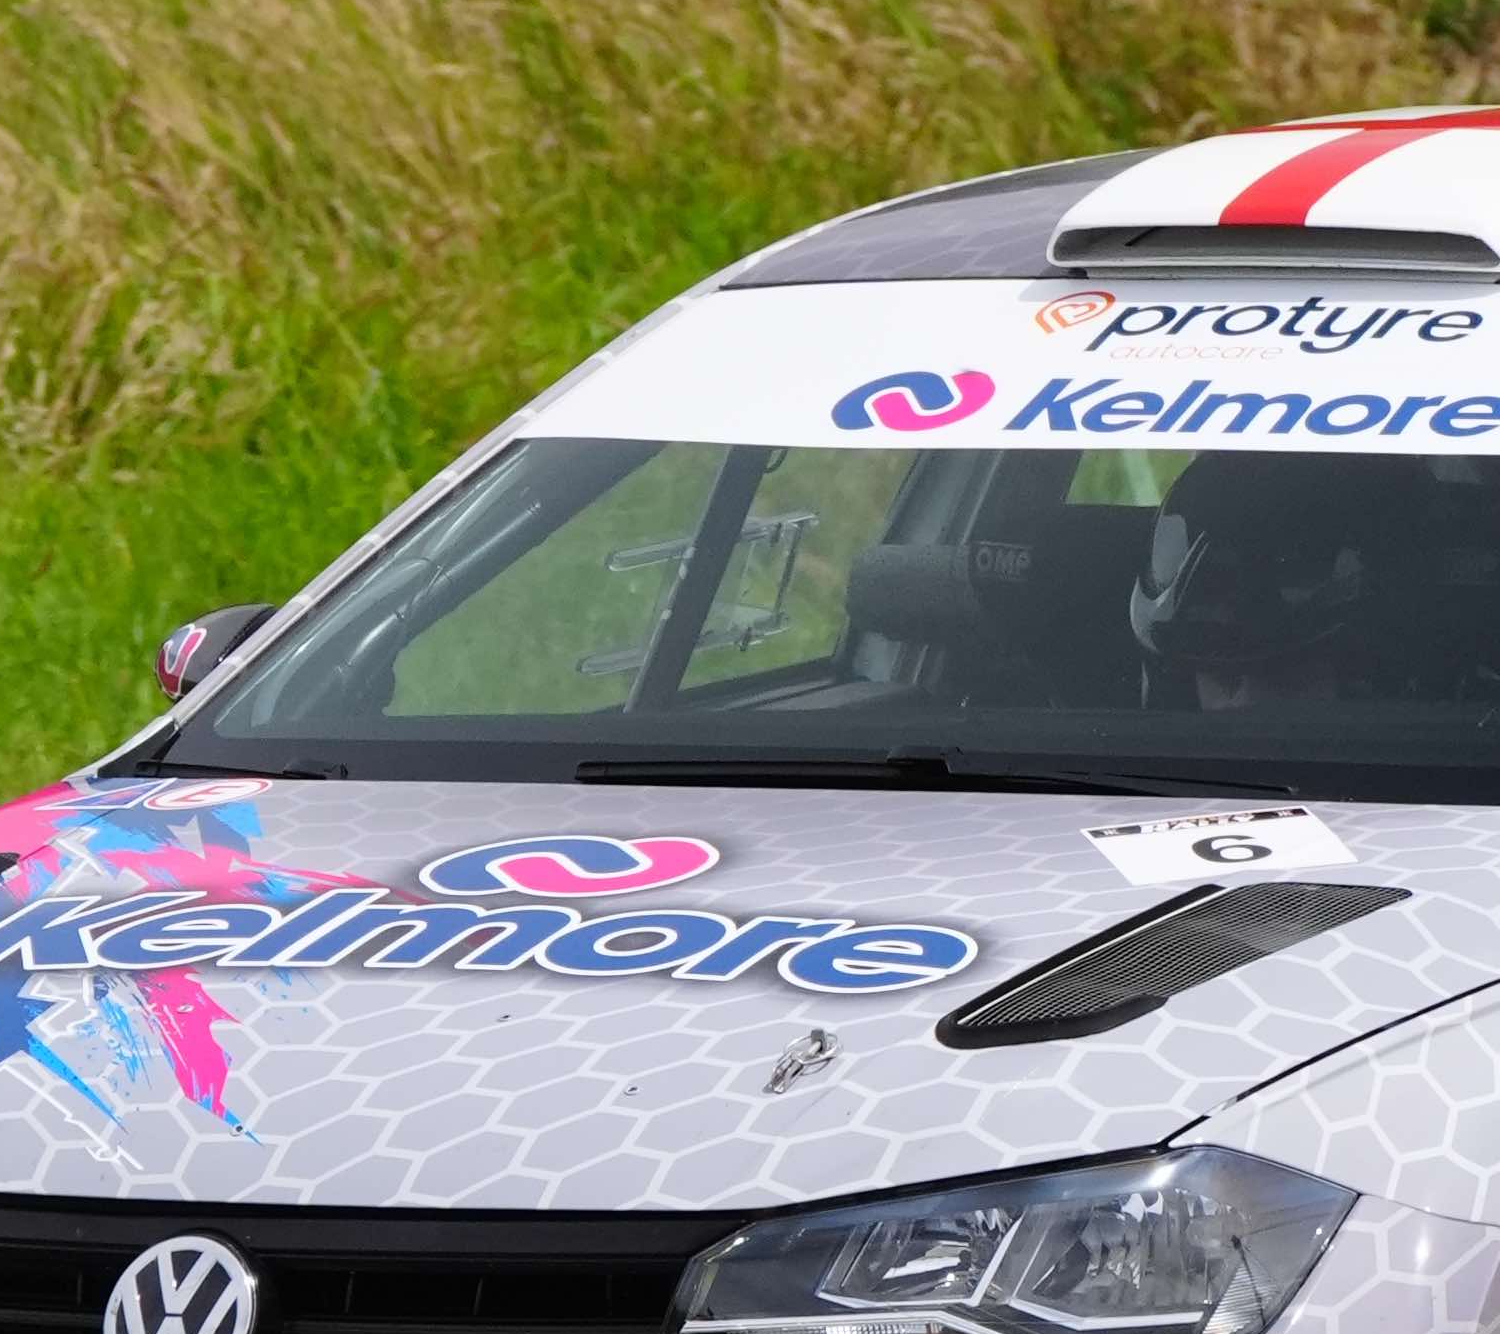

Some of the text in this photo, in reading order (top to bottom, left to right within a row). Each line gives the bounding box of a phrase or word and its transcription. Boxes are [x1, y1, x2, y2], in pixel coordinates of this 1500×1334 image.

[1085, 296, 1484, 355] protyre
[1110, 342, 1284, 362] autocare
[1191, 834, 1272, 863] 6
